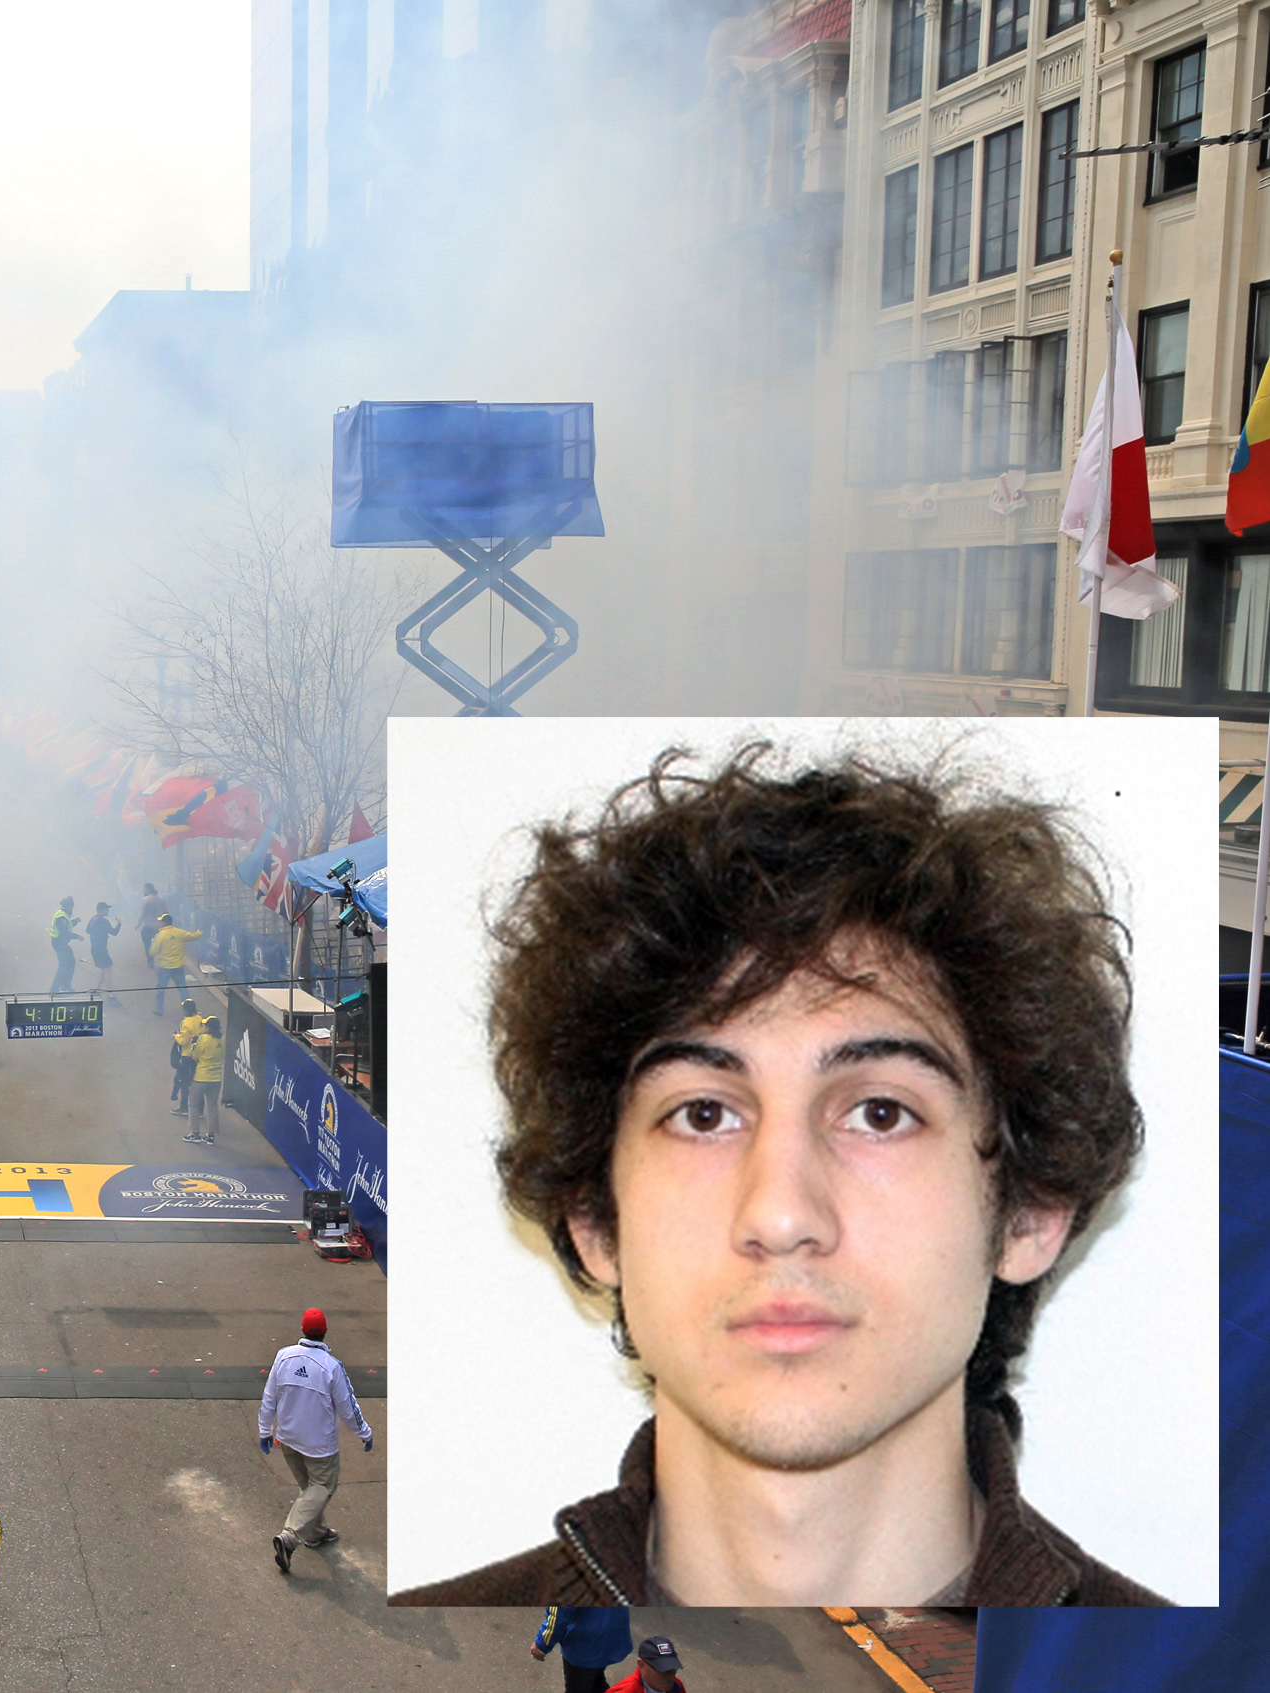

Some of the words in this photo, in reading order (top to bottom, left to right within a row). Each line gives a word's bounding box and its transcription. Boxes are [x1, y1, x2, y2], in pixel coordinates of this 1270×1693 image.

[25, 1005, 98, 1022] 4:10:10
[233, 1059, 256, 1091] adidas
[268, 1064, 287, 1113] John
[283, 1073, 311, 1144] Hancock
[347, 1147, 370, 1204] John
[120, 1190, 189, 1198] BOSTON
[193, 1192, 288, 1201] MARATHON
[141, 1199, 194, 1213] John
[191, 1199, 281, 1213] Hancock
